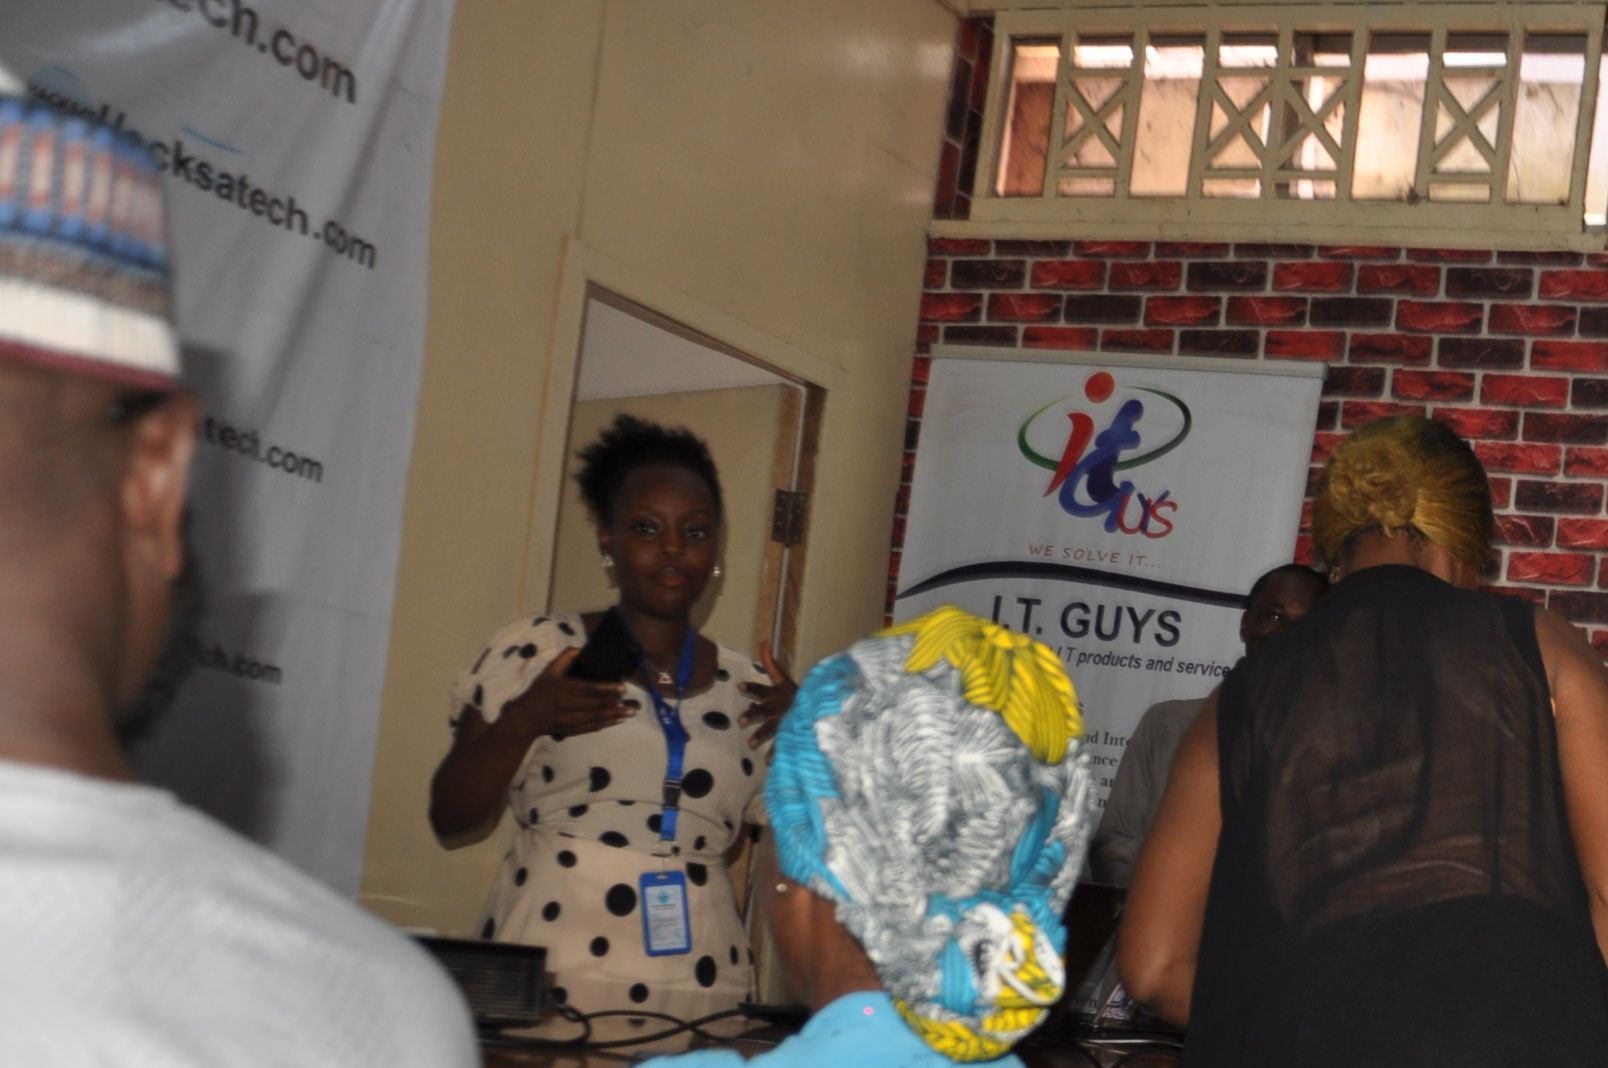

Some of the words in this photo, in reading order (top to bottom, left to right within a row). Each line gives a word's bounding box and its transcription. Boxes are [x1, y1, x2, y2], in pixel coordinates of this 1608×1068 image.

[157, 0, 357, 103] ch.com
[1029, 543, 1054, 557] WE
[1062, 547, 1121, 564] SOLVE
[991, 595, 1043, 635] I.T.
[1059, 601, 1182, 647] GUYS
[1077, 650, 1141, 669] products
[1146, 659, 1175, 672] and
